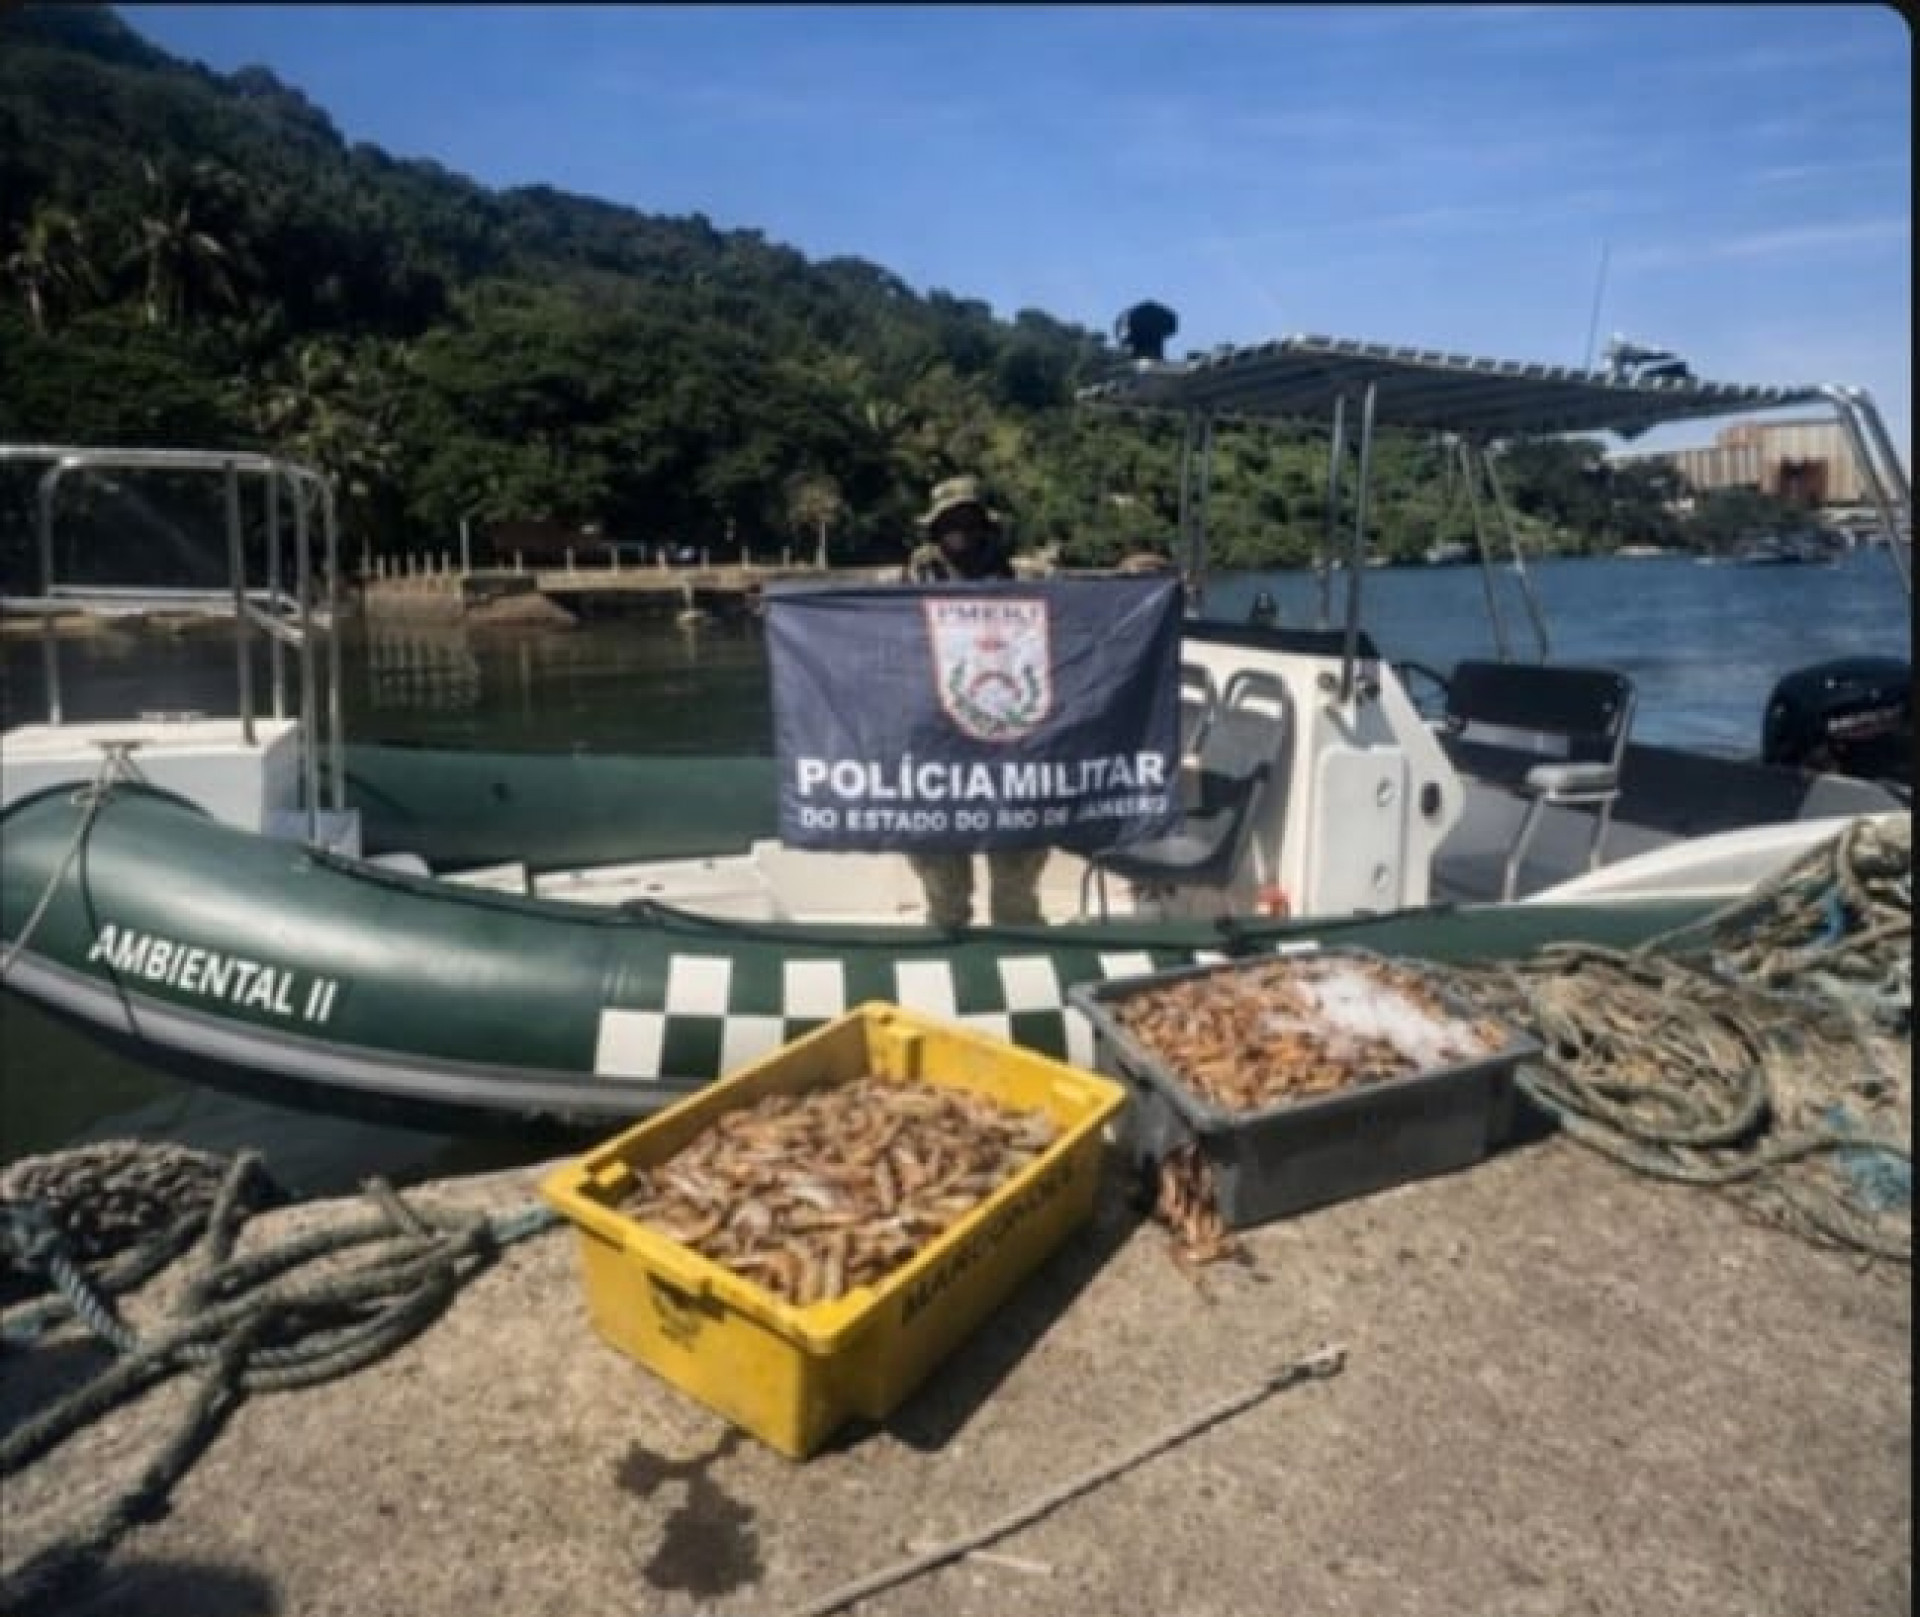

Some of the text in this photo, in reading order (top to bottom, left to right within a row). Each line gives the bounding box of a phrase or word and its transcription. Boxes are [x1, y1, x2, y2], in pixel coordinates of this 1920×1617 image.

[797, 751, 1165, 801] POLÍCIA MILITAR
[801, 805, 837, 829] DO
[845, 808, 948, 831] ESTADO
[954, 809, 990, 831] DO
[996, 808, 1037, 830] RIO
[88, 924, 338, 1024] AMBIENTAL II
